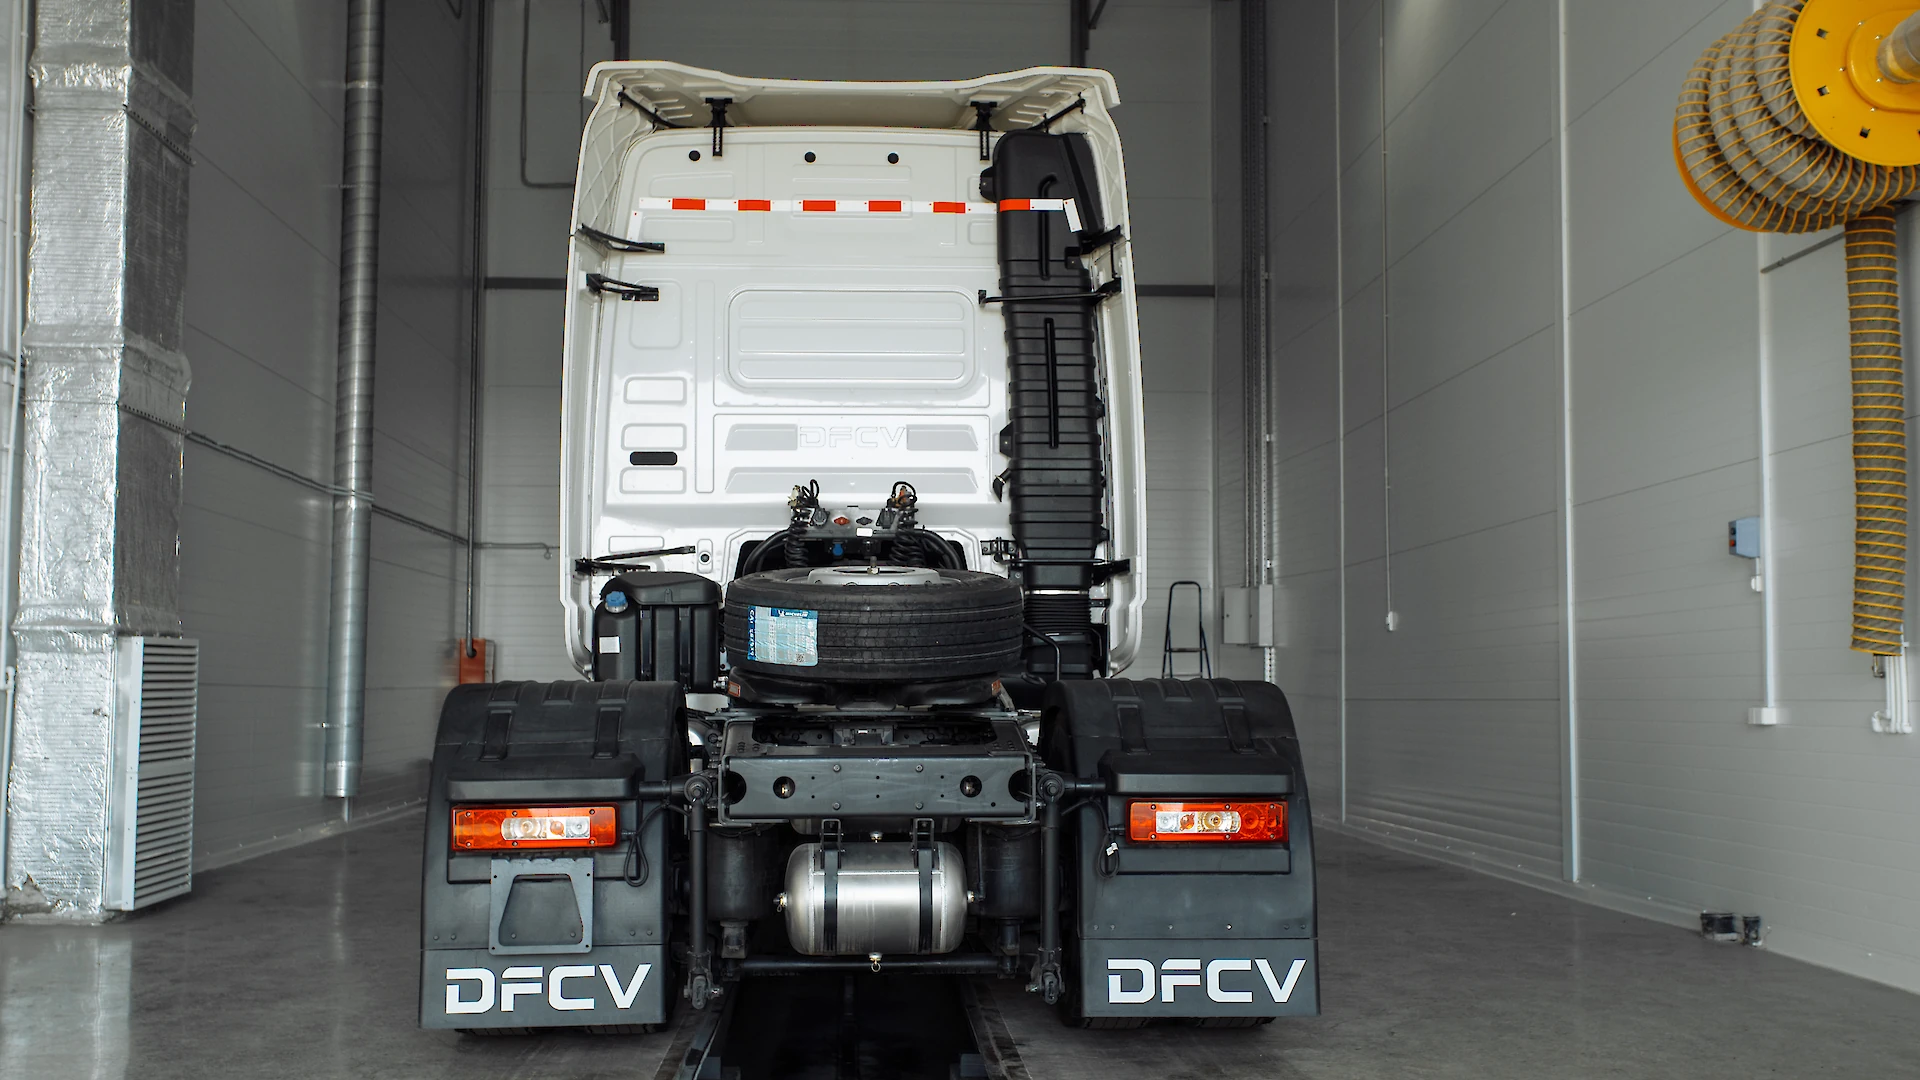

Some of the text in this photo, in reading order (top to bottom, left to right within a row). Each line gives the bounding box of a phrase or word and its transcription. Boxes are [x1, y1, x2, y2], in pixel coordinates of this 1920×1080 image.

[799, 426, 906, 448] DFCV
[446, 963, 652, 1014] DFCV
[1107, 958, 1307, 1004] DFCV
